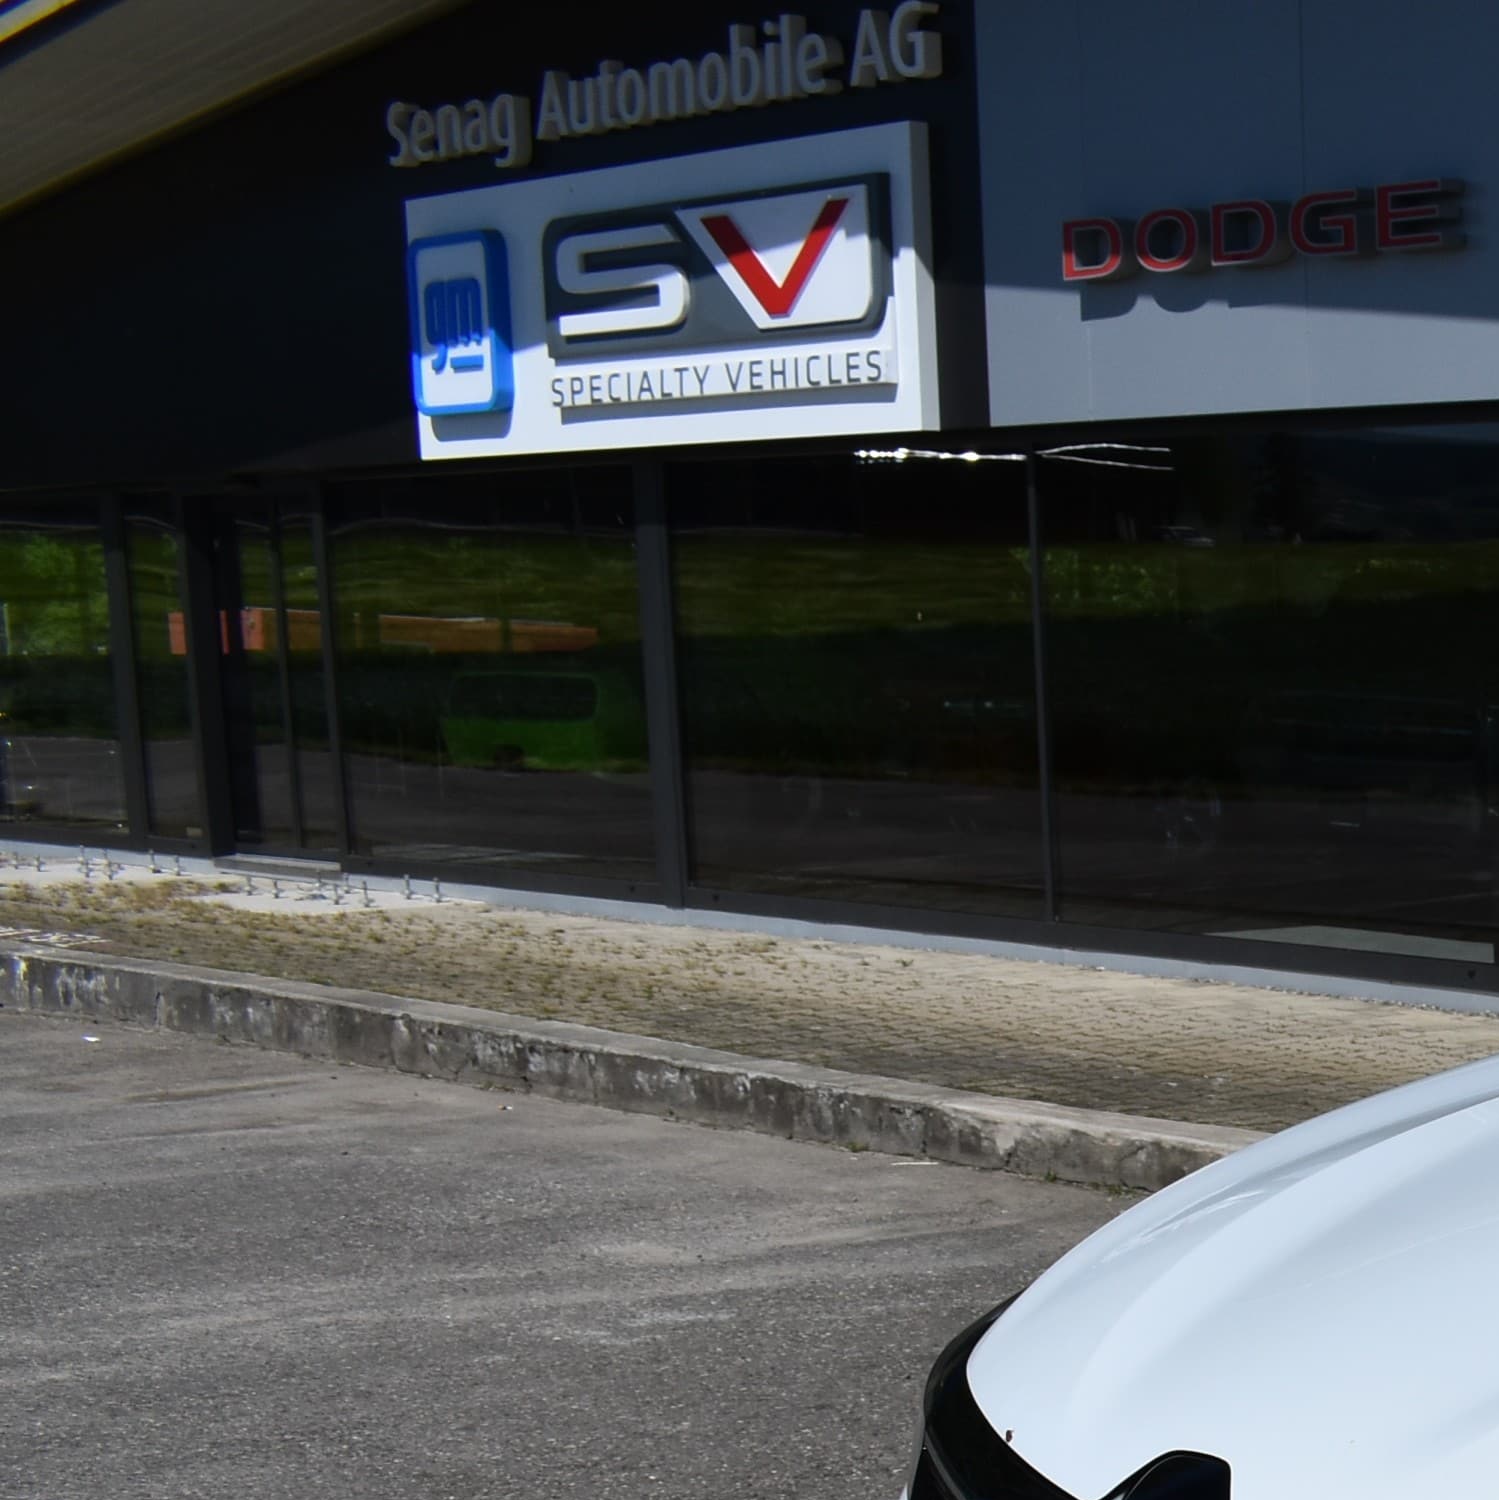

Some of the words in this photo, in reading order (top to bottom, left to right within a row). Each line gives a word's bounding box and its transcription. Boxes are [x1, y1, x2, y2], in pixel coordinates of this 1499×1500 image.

[386, 93, 532, 167] Senag
[535, 13, 843, 141] Automobile
[849, 1, 942, 87] AG
[555, 198, 850, 337] SV
[1061, 178, 1464, 282] DODGE
[551, 366, 710, 408] SPECIALTY
[725, 349, 883, 393] VEHICLES
